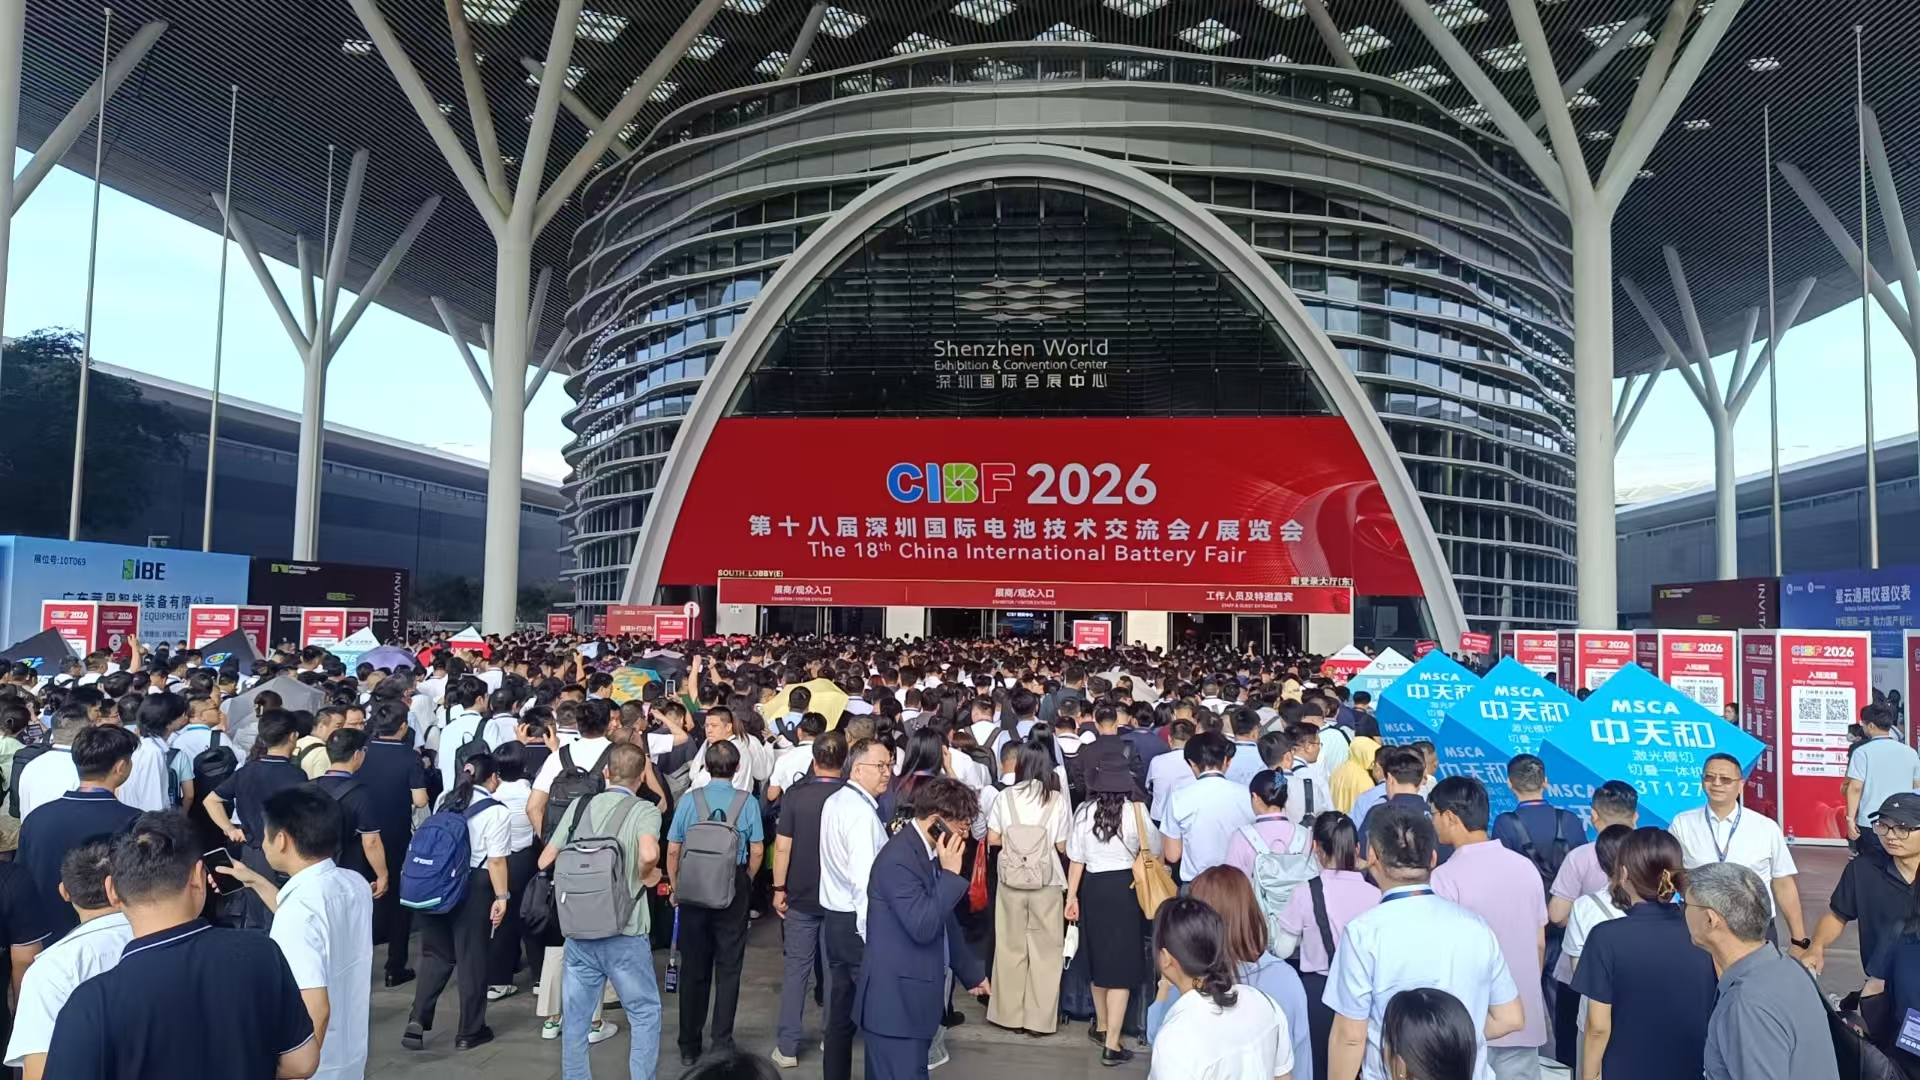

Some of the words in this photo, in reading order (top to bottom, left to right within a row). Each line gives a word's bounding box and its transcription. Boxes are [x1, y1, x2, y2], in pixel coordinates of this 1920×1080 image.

[934, 340, 1035, 357] Shenzhen
[1043, 339, 1109, 356] World
[934, 360, 989, 371] Exhibition
[992, 360, 1001, 370] &
[1003, 359, 1067, 371] Convention
[1070, 358, 1108, 370] Center
[936, 374, 1108, 389] 深圳国际会展中心
[886, 463, 1016, 504] CIBF
[1027, 463, 1157, 505] 2026
[748, 515, 1305, 542] 第十八届深圳国际电池技术交流会/展览会
[807, 541, 846, 558] The
[855, 541, 892, 559] 18th
[899, 543, 958, 560] China
[966, 542, 1106, 562] International
[1115, 545, 1196, 567] Battery
[1205, 546, 1247, 564] Fair
[718, 569, 745, 577] SOUTH
[748, 570, 784, 578] LOBBY(E)
[144, 611, 186, 623] EQUIPMENT
[1698, 643, 1724, 653] 2026
[1824, 646, 1855, 657] 2026
[1419, 672, 1461, 682] MSCA
[1494, 685, 1545, 698] MSCA
[1480, 700, 1570, 723] 中天和
[1611, 699, 1681, 716] MSCA
[1384, 723, 1415, 733] MSCA
[1590, 717, 1716, 748] 中天和
[1444, 746, 1485, 759] MSCA
[1635, 780, 1703, 797] 3T127
